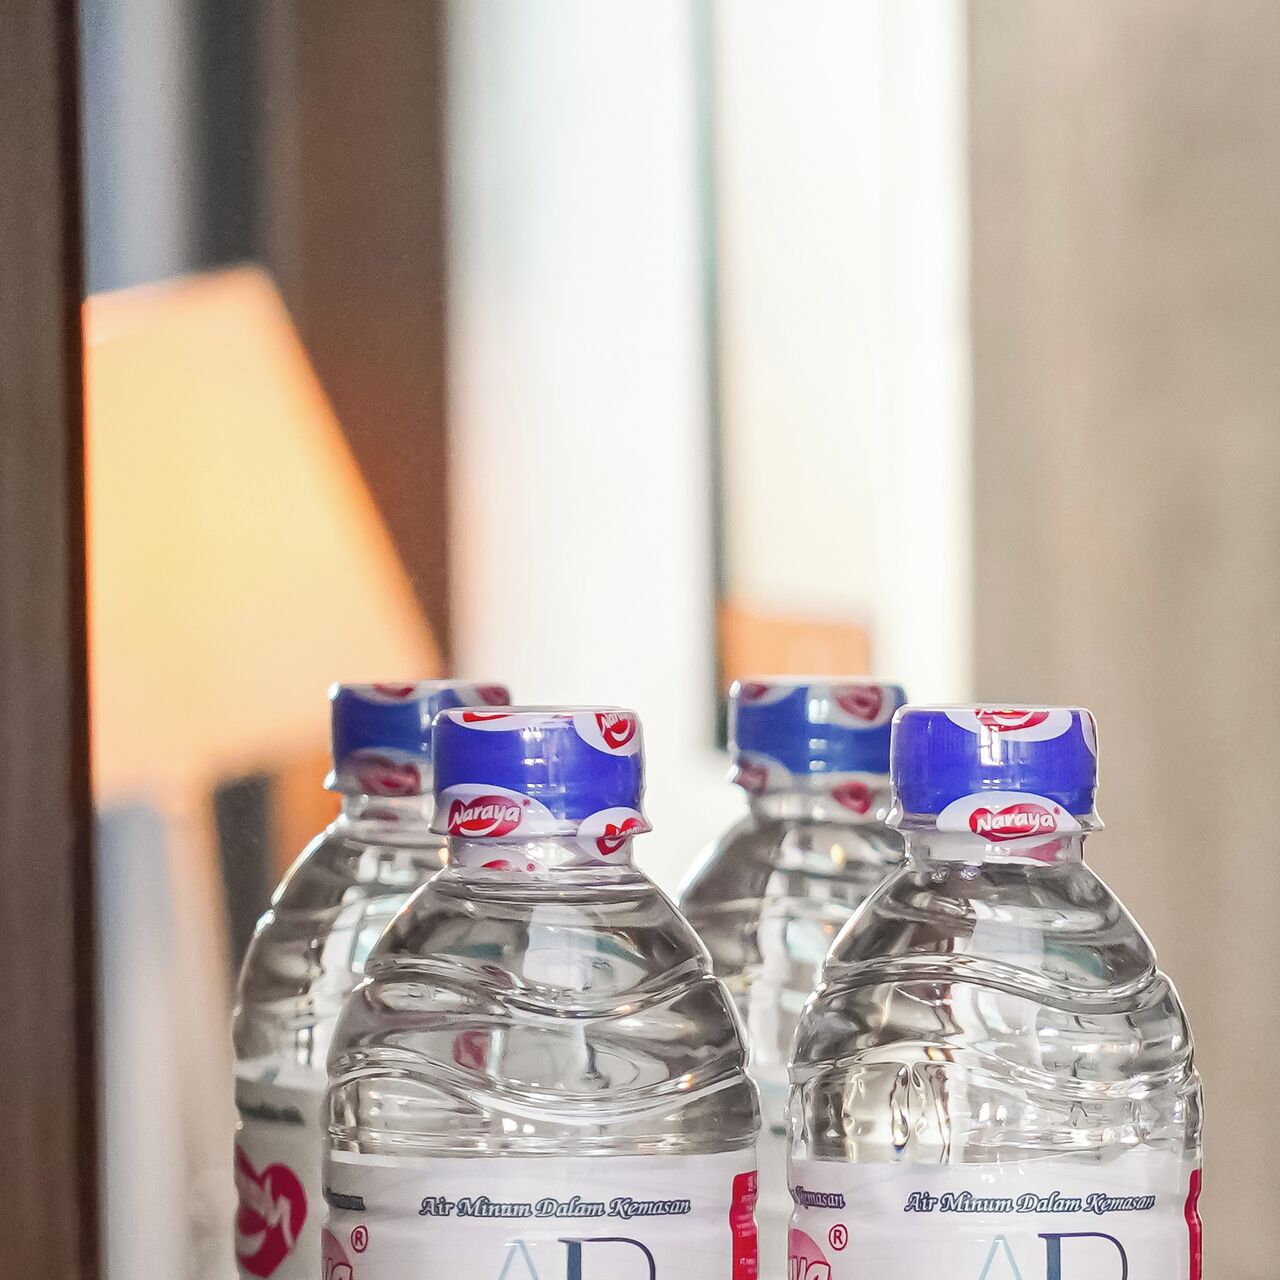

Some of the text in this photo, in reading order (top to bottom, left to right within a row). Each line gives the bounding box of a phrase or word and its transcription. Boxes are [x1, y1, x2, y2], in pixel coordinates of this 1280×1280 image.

[449, 802, 521, 831] Naraya
[976, 812, 1055, 833] Naraya
[419, 1196, 691, 1219] Air Minum Dalam Kemasan
[904, 1191, 1155, 1215] Air Minum Dalam Kemasan
